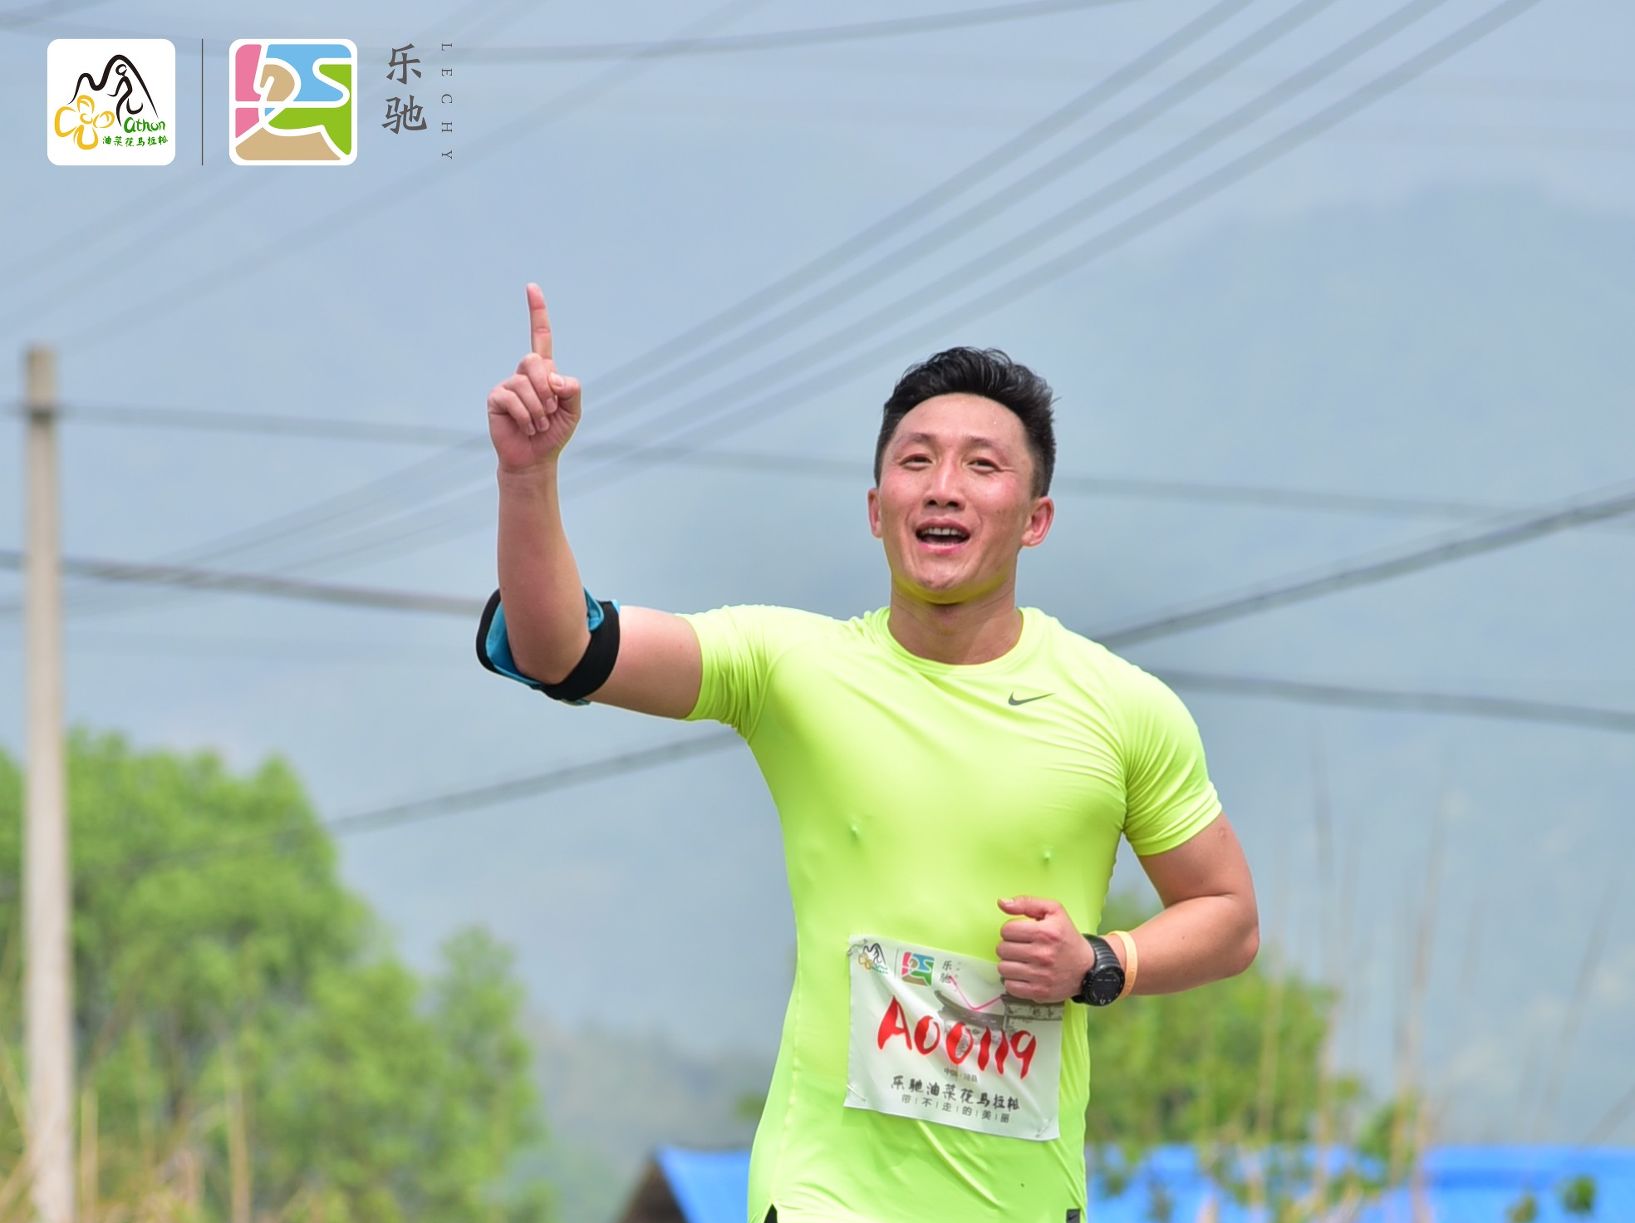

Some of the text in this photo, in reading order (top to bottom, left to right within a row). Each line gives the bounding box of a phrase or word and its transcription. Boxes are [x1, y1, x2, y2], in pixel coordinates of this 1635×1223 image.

[877, 995, 1037, 1080] A00119
[891, 1075, 1021, 1111] 乐驰油菜花马拉松
